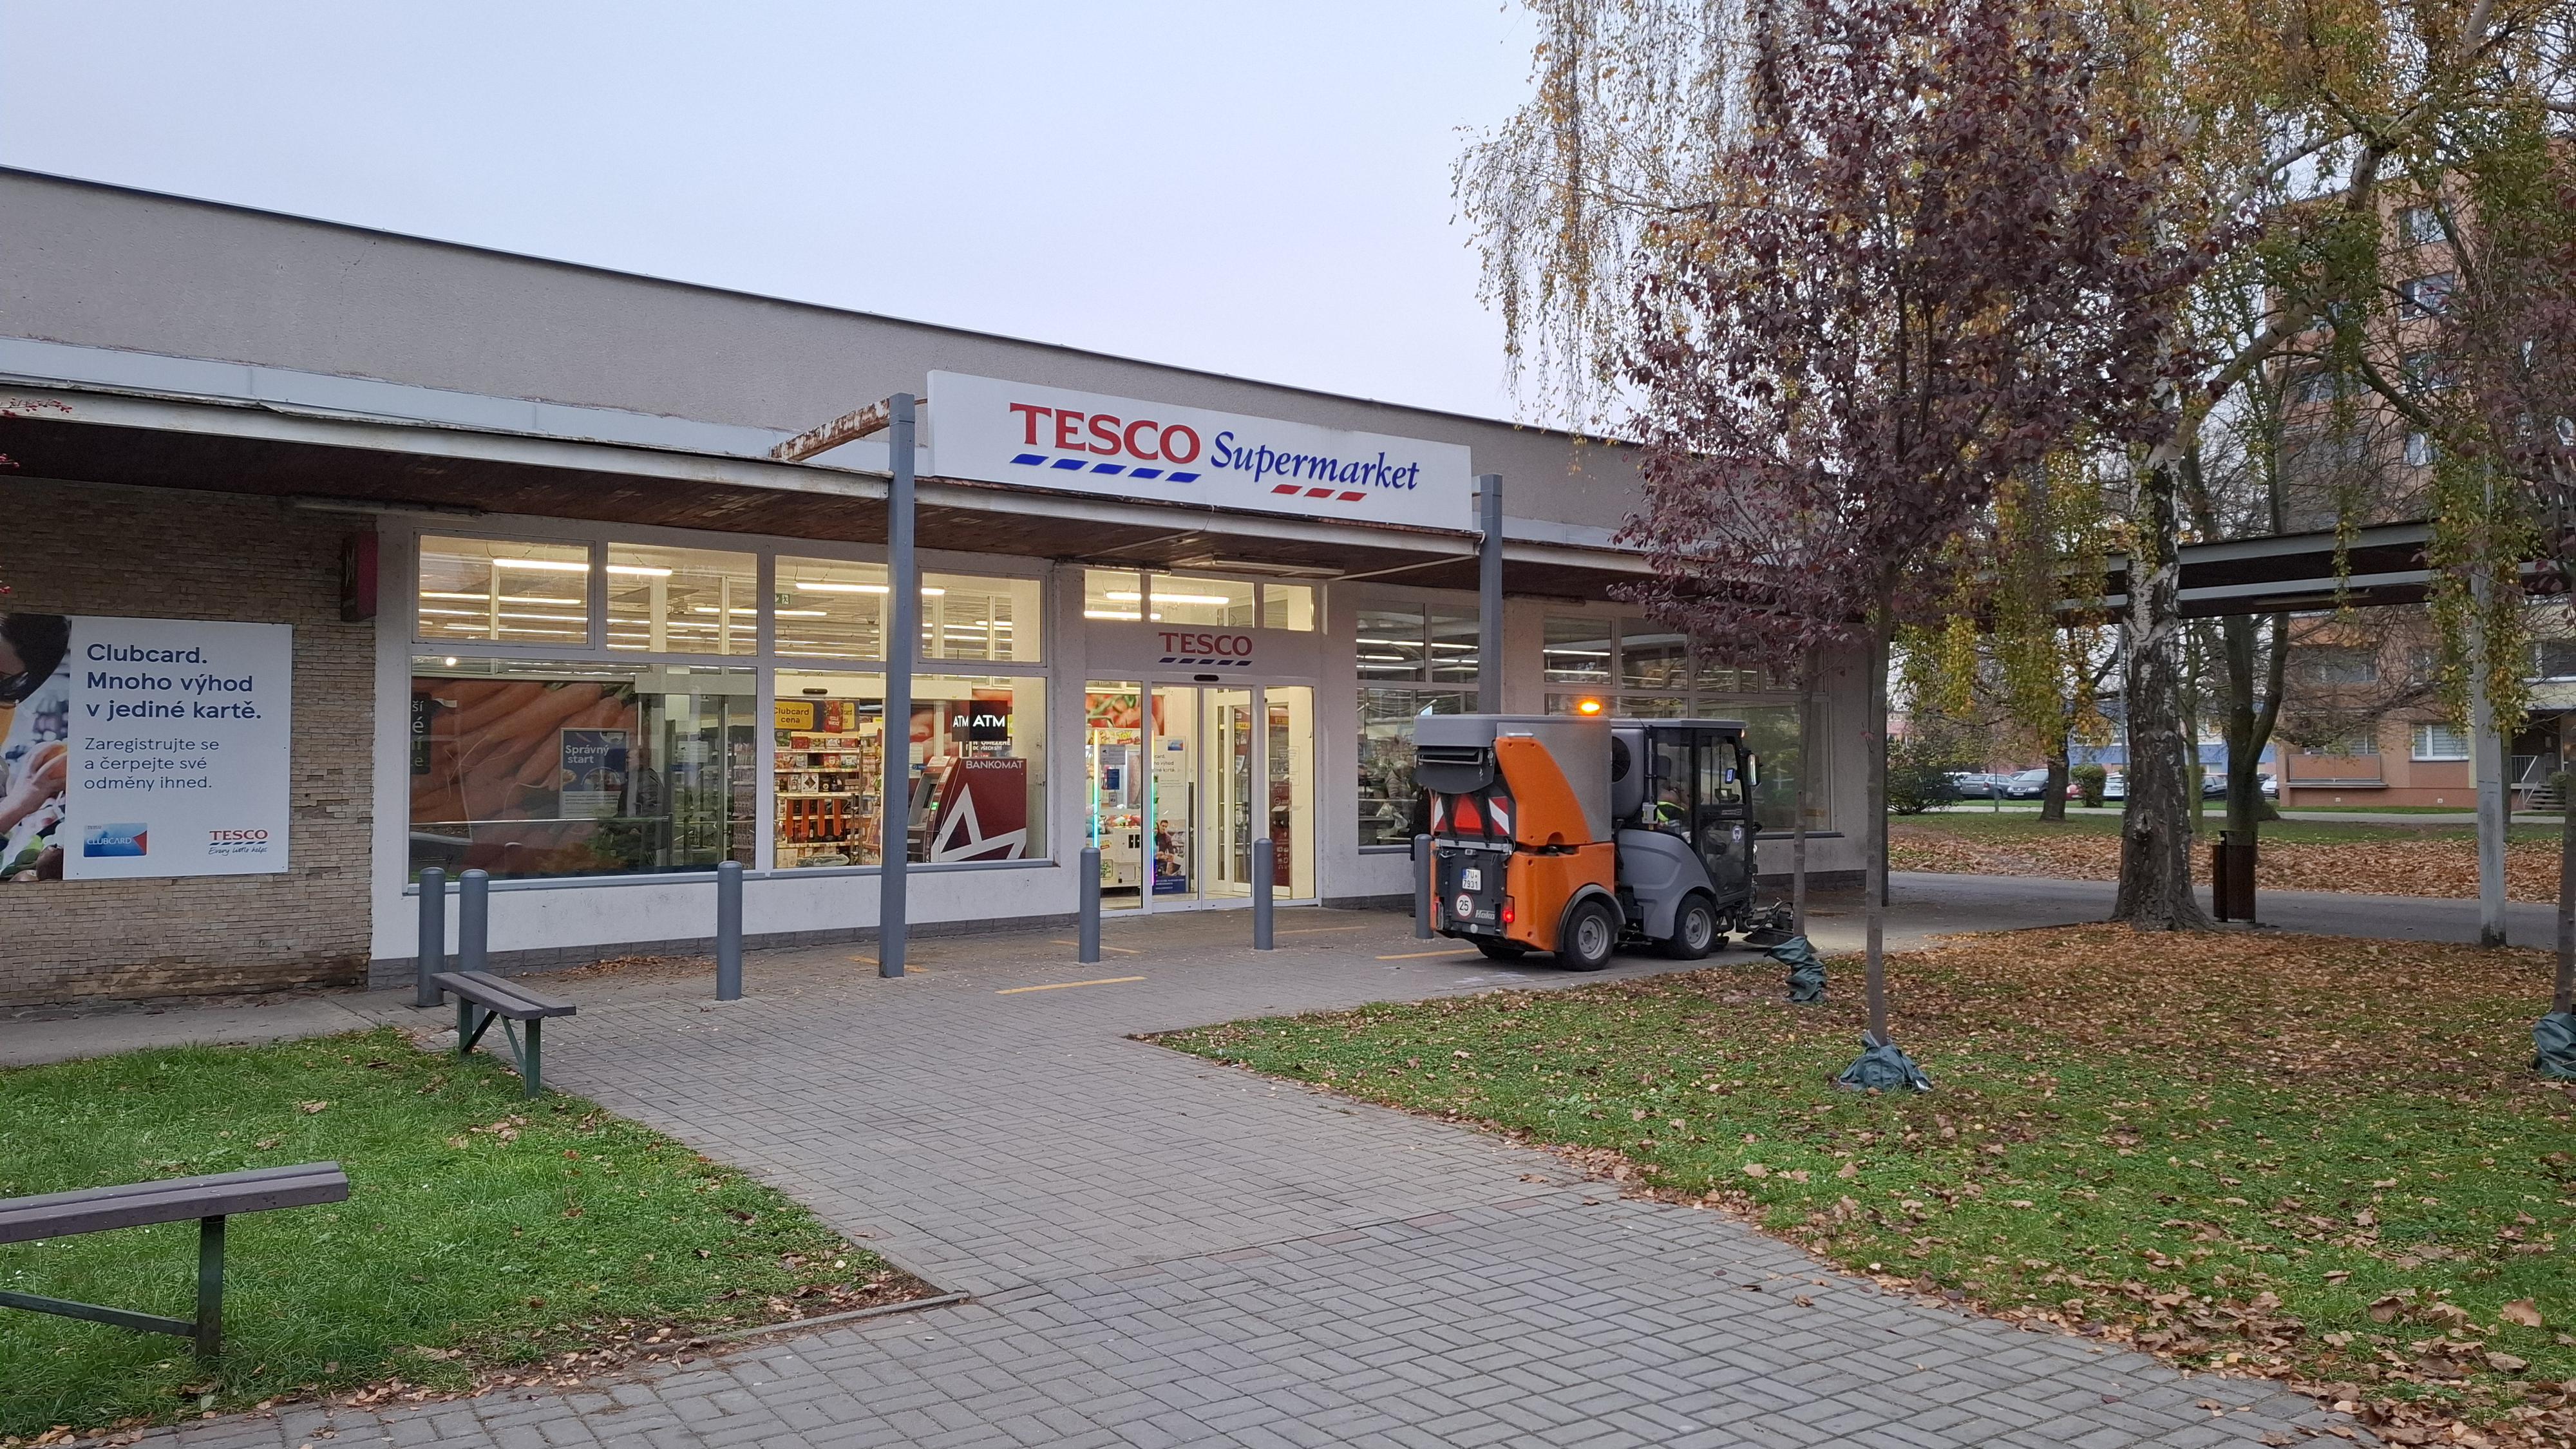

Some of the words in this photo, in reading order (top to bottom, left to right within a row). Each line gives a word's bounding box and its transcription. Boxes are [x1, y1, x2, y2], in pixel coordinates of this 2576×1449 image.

[1010, 402, 1200, 464] TESCO
[1211, 431, 1419, 490] Supermarket
[1159, 632, 1253, 656] TESCO
[87, 643, 207, 664] Clubcard.
[87, 672, 173, 690] Mnoho
[180, 674, 253, 696] výhod
[86, 704, 100, 717] v
[106, 700, 185, 722] jediné
[193, 701, 261, 719] kartě.
[774, 707, 810, 715] Clubcard
[953, 715, 969, 728] ATM
[972, 714, 1005, 727] ATM
[85, 737, 196, 753] Zaregistrujte
[201, 741, 220, 751] se
[565, 744, 609, 757] Správný
[84, 760, 94, 770] a
[100, 756, 175, 773] čerpejte
[180, 757, 207, 770] své
[567, 755, 594, 764] start
[966, 761, 1023, 769] BANKOMAT
[84, 776, 155, 792] odměny
[160, 776, 213, 789] ihned.
[209, 829, 268, 840] TESCO
[1459, 900, 1469, 911] 25
